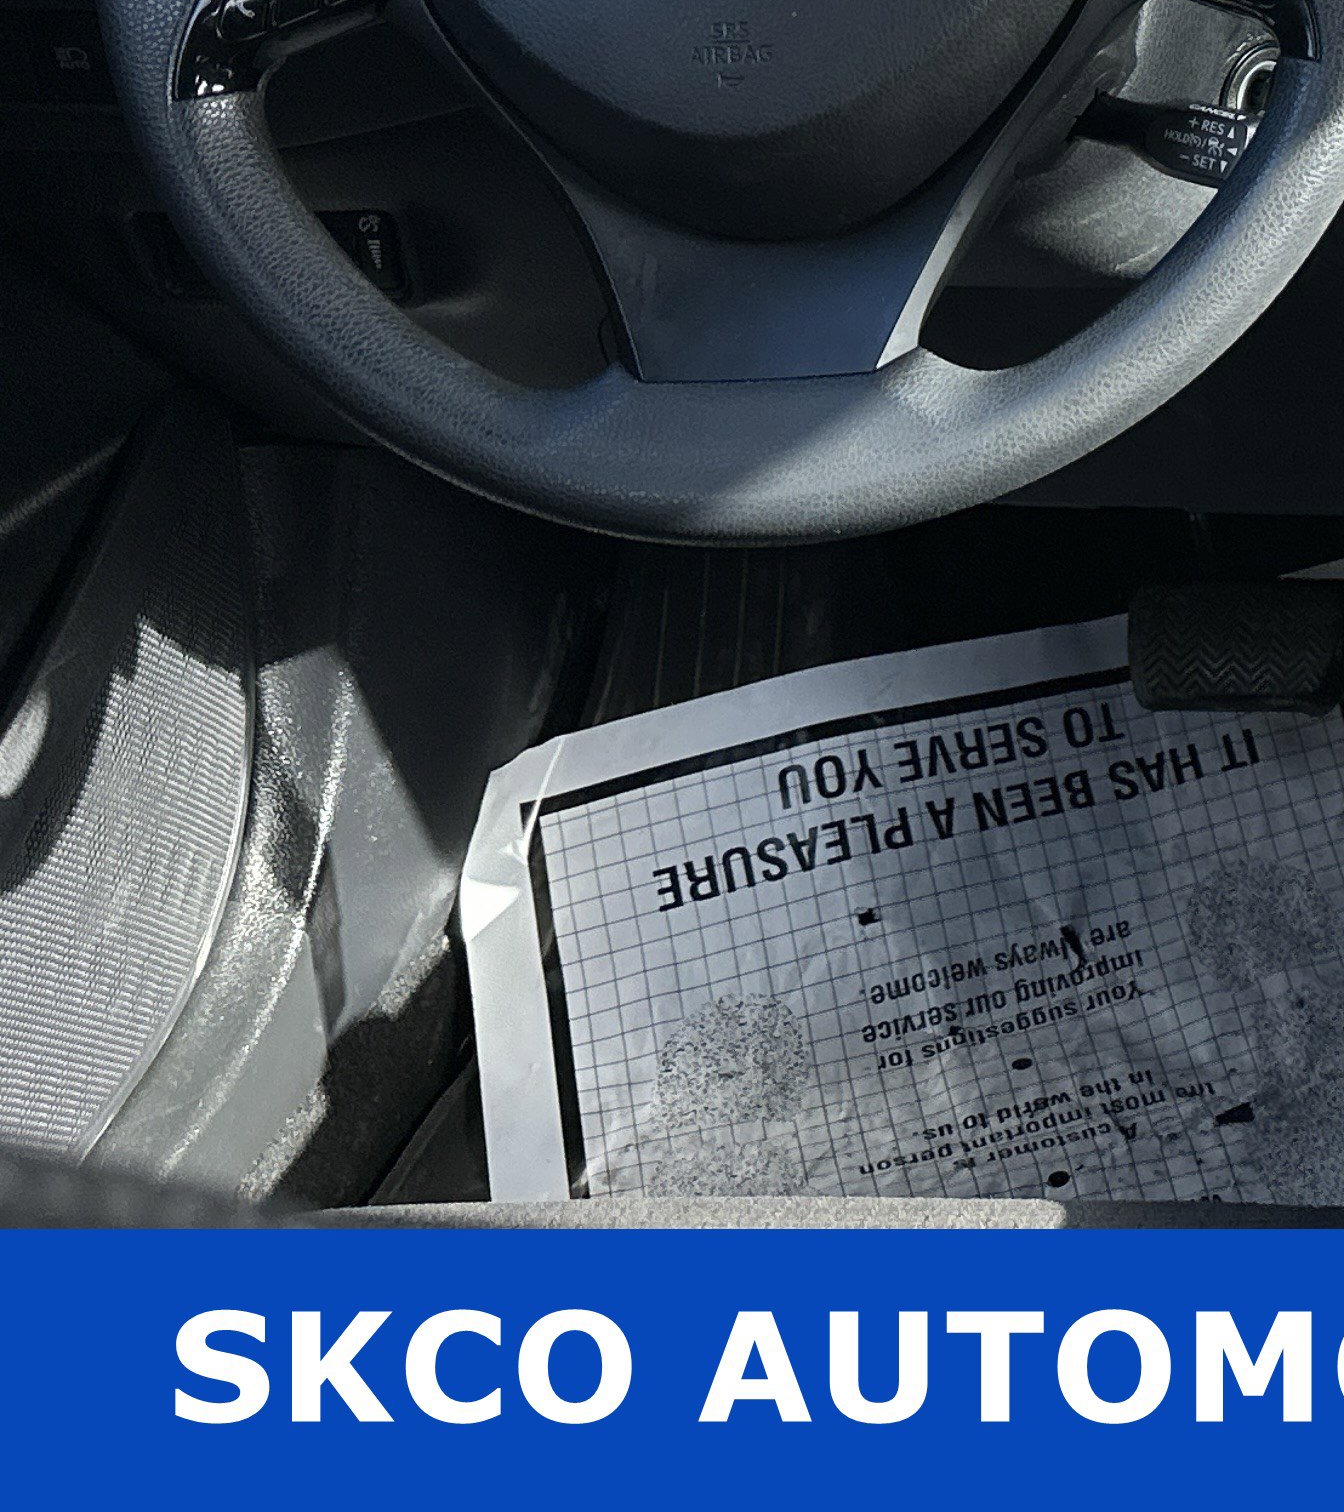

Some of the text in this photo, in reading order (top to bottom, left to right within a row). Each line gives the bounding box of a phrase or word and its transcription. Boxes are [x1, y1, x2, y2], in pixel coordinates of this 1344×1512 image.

[692, 44, 774, 64] AIRBAG
[777, 702, 1125, 810] TO SERVE YOU
[652, 728, 1261, 913] IT HAS BEEN A PLEASURE
[859, 920, 1131, 1006] are welcome.
[862, 1002, 957, 1043] service
[965, 989, 1006, 1017] our
[877, 980, 1148, 1071] Your suggestions for
[1081, 1076, 1122, 1099] the
[1103, 1090, 1167, 1115] most
[961, 1105, 1093, 1150] important
[962, 1112, 989, 1131] to
[858, 1143, 954, 1176] person
[986, 1123, 1112, 1164] customer
